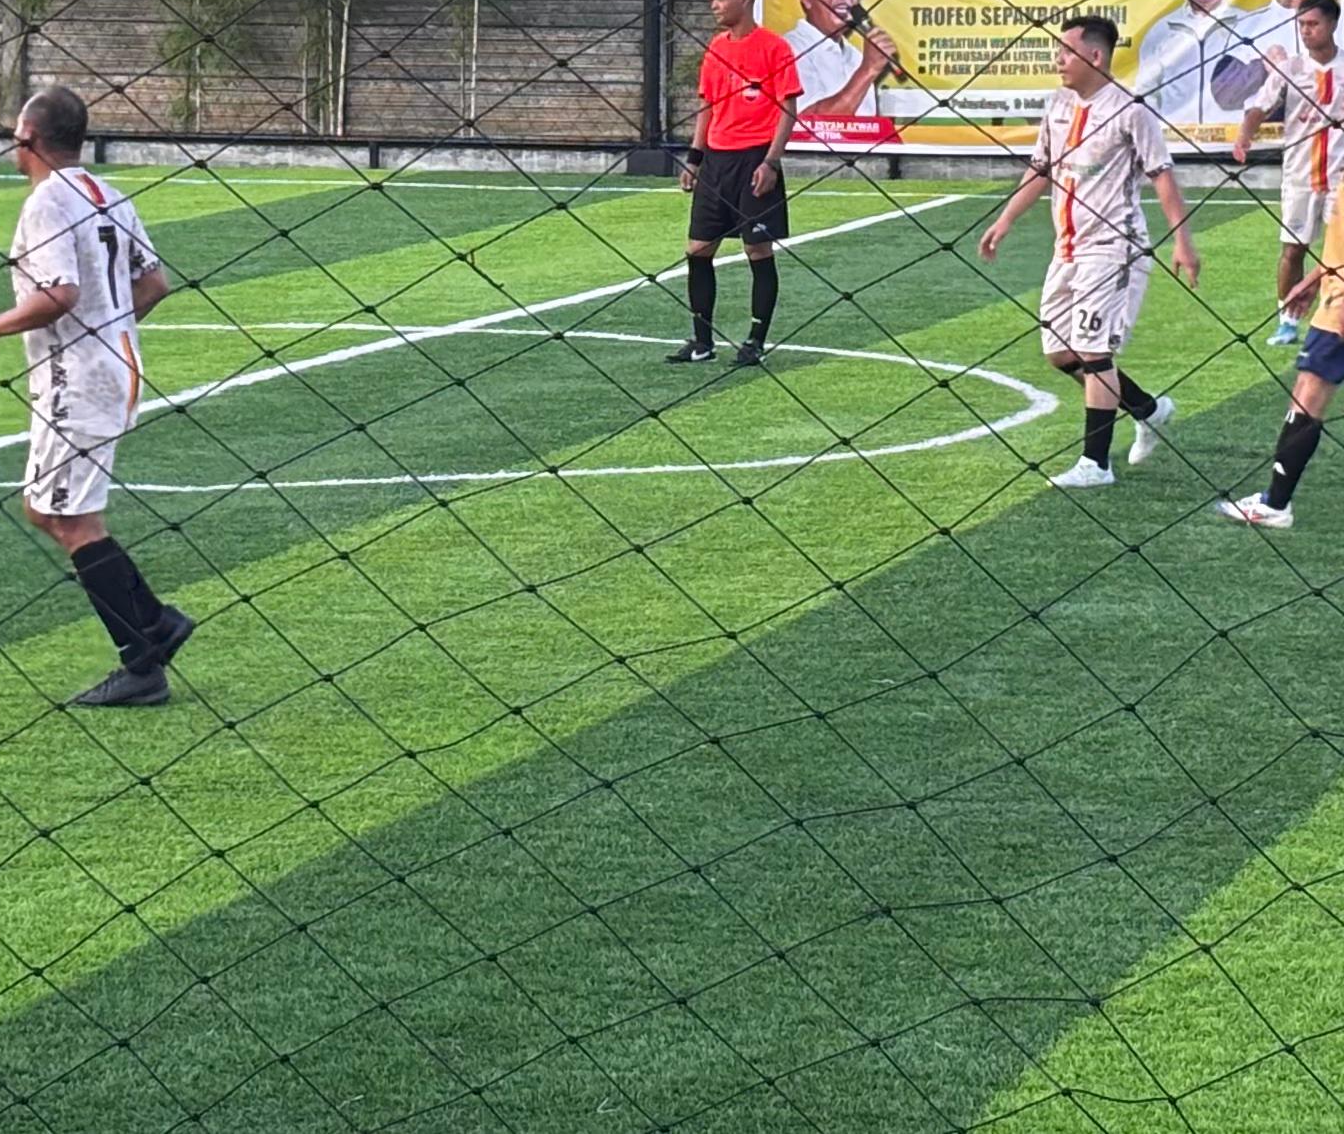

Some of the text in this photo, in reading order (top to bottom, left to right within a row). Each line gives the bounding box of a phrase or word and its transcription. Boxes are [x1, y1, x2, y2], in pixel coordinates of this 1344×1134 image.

[911, 7, 983, 27] TROFEO
[929, 51, 941, 62] PT
[1013, 50, 1052, 61] LISTRIK
[929, 65, 941, 76] PT
[1000, 64, 1030, 75] KEPRI
[98, 225, 119, 309] 7
[1078, 309, 1102, 332] 26
